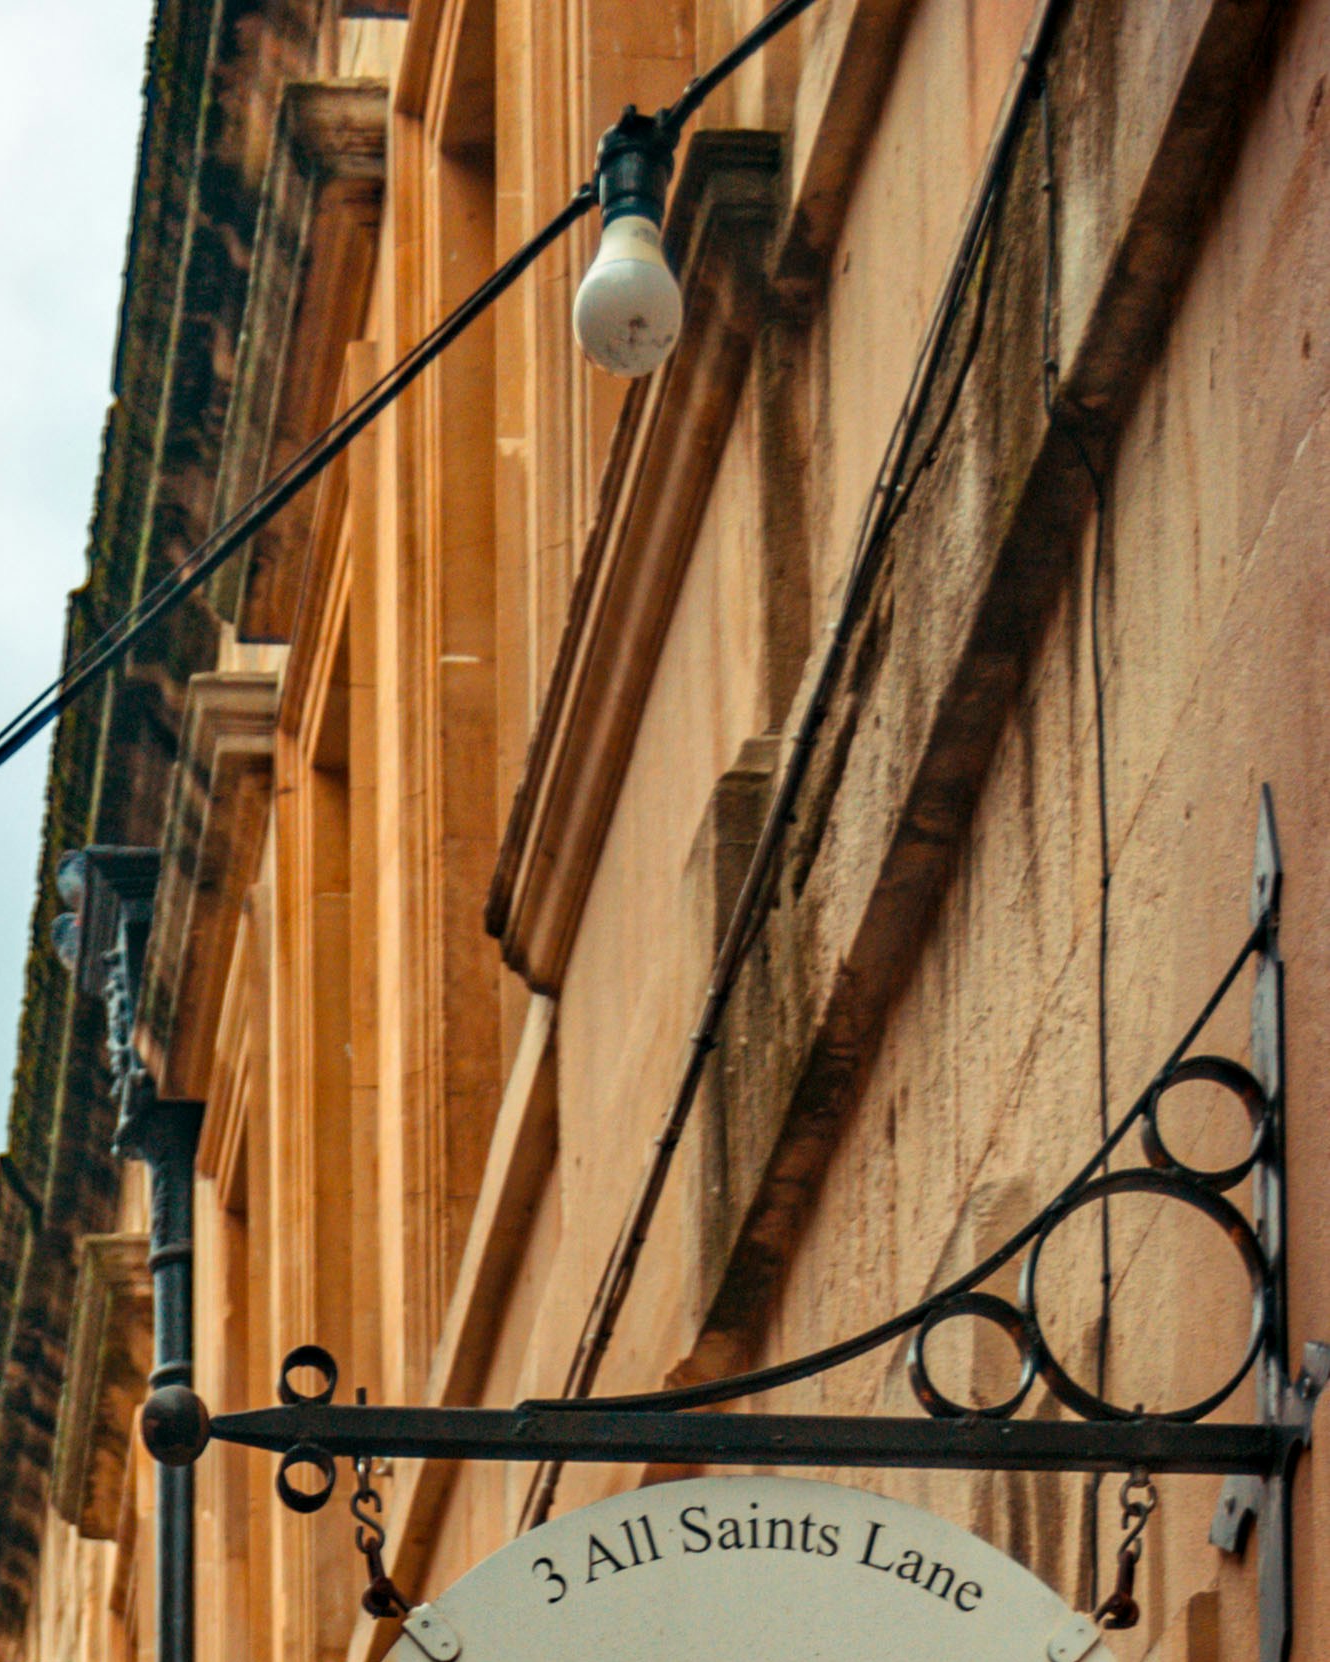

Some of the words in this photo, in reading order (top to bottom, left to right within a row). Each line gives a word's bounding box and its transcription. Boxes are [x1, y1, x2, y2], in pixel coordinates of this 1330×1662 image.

[532, 1555, 570, 1605] 3
[584, 1513, 663, 1586] All
[680, 1502, 842, 1559] Saints
[856, 1518, 986, 1614] Lane
